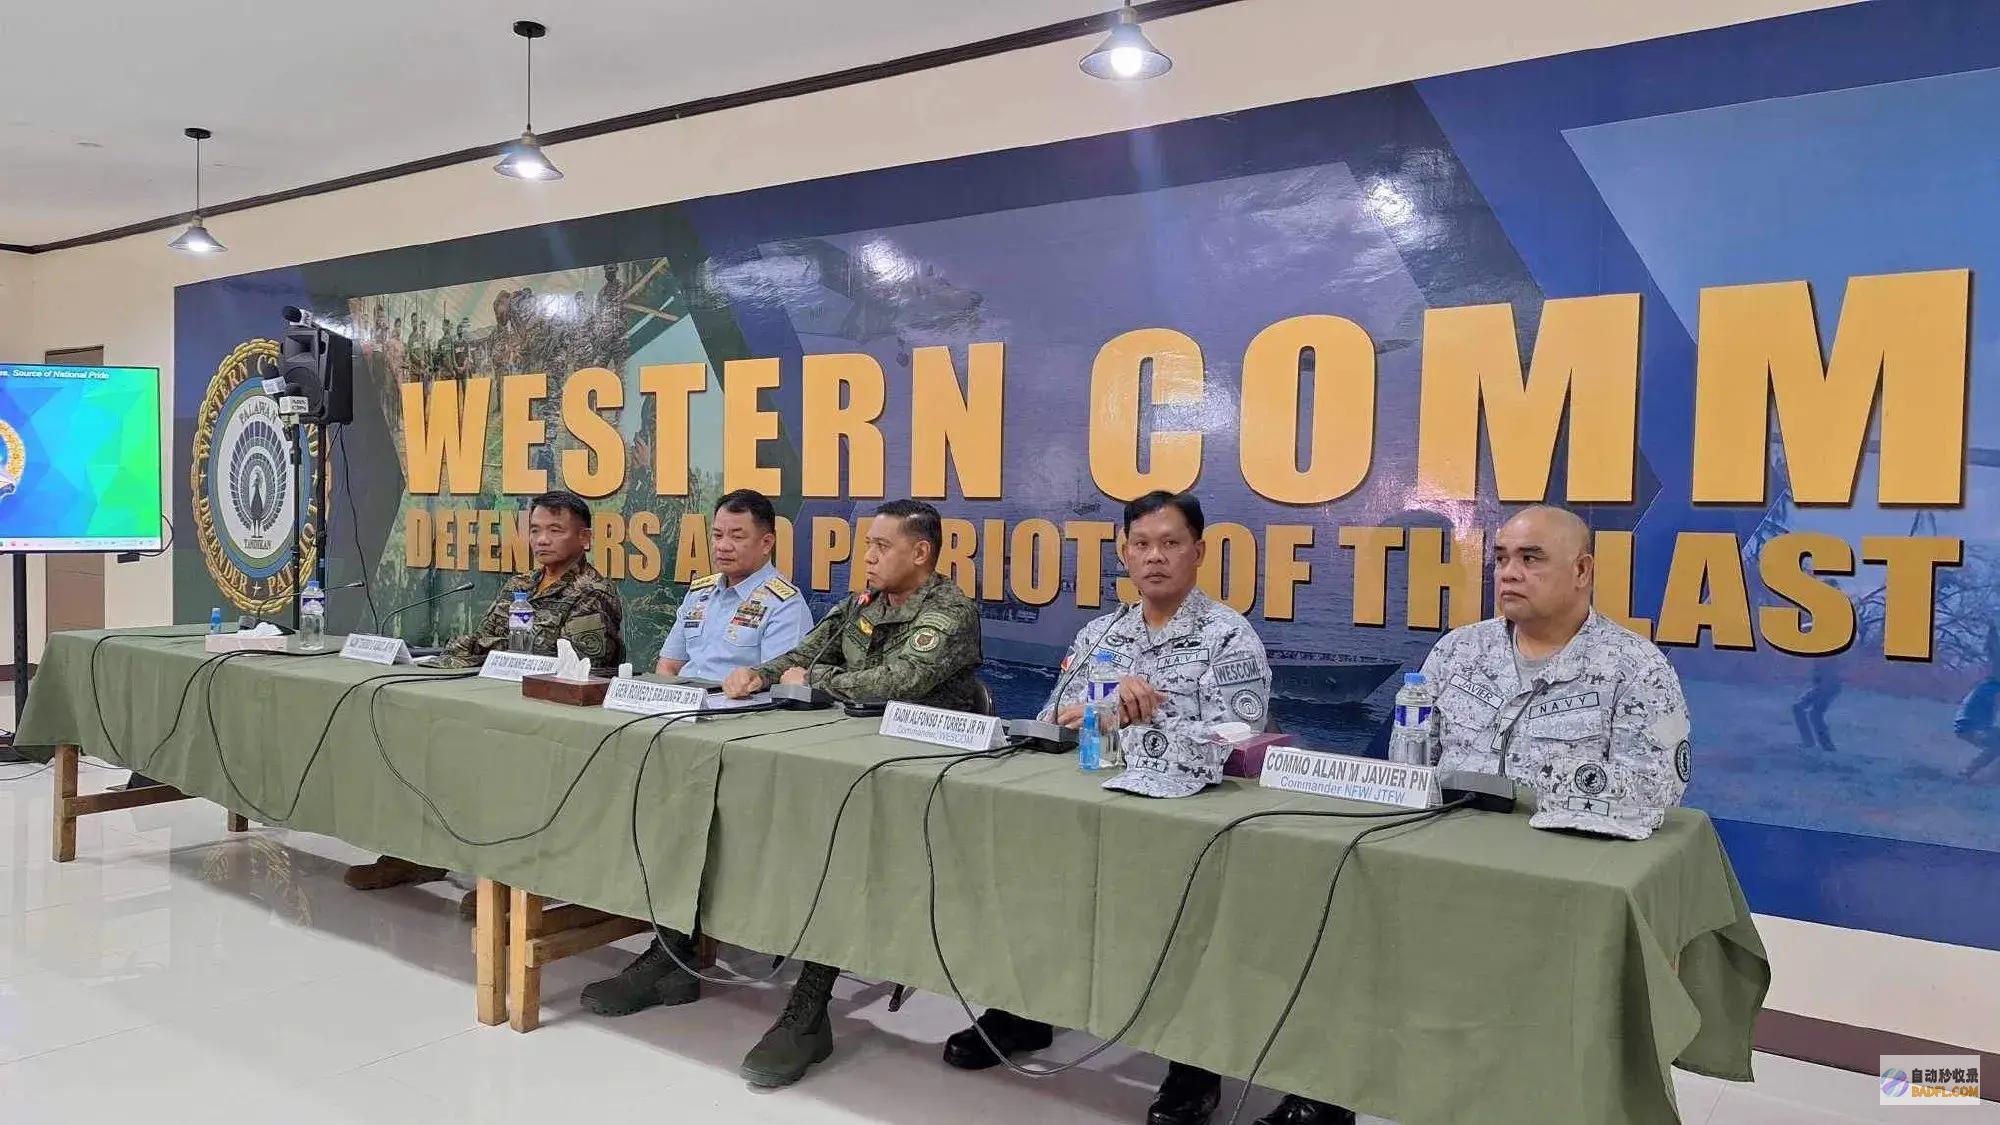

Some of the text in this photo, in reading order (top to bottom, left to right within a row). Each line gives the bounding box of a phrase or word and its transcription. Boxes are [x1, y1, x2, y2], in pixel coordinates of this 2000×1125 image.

[13, 369, 41, 377] Source
[54, 370, 87, 379] National
[400, 269, 1970, 504] WESTERN COMM
[407, 508, 662, 582] DEFENRS
[1198, 522, 1314, 620] OF
[1339, 526, 1484, 629] TH
[1595, 530, 1962, 660] LAST
[1215, 660, 1260, 681] WESCOM
[1459, 679, 1493, 702] JAVIER
[1539, 696, 1586, 714] NAVY
[911, 710, 938, 727] ALFONSO
[943, 715, 967, 731] TORRES
[967, 719, 976, 733] JR
[976, 720, 987, 735] PN
[1266, 753, 1429, 791] COMMO ALAN M JAVIER PN
[1281, 776, 1342, 795] Commander
[1374, 788, 1405, 802] JTFW
